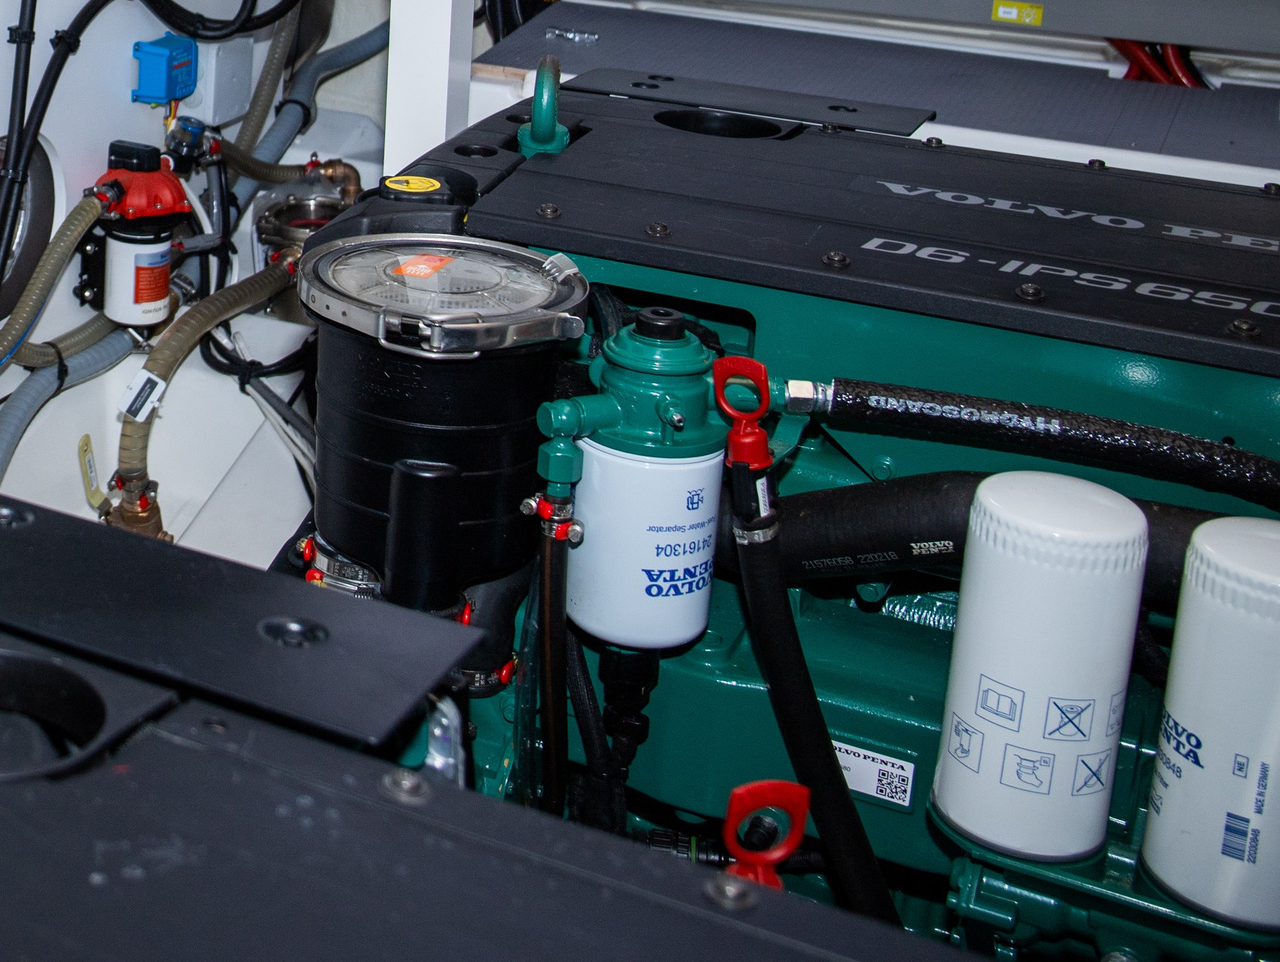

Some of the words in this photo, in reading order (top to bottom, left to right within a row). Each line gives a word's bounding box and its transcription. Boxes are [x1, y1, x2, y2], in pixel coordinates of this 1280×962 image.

[876, 180, 1146, 230] VOLVO
[868, 395, 1062, 435] HYDROSCAND
[646, 524, 686, 533] Separator
[655, 534, 712, 557] 24161304
[910, 540, 953, 549] VOLVO
[857, 551, 899, 564] 220218
[862, 753, 907, 772] PENTA
[1236, 760, 1246, 773] NE
[1257, 761, 1270, 791] GERMANY
[1253, 796, 1264, 815] MADE
[1246, 828, 1261, 865] 22030848
